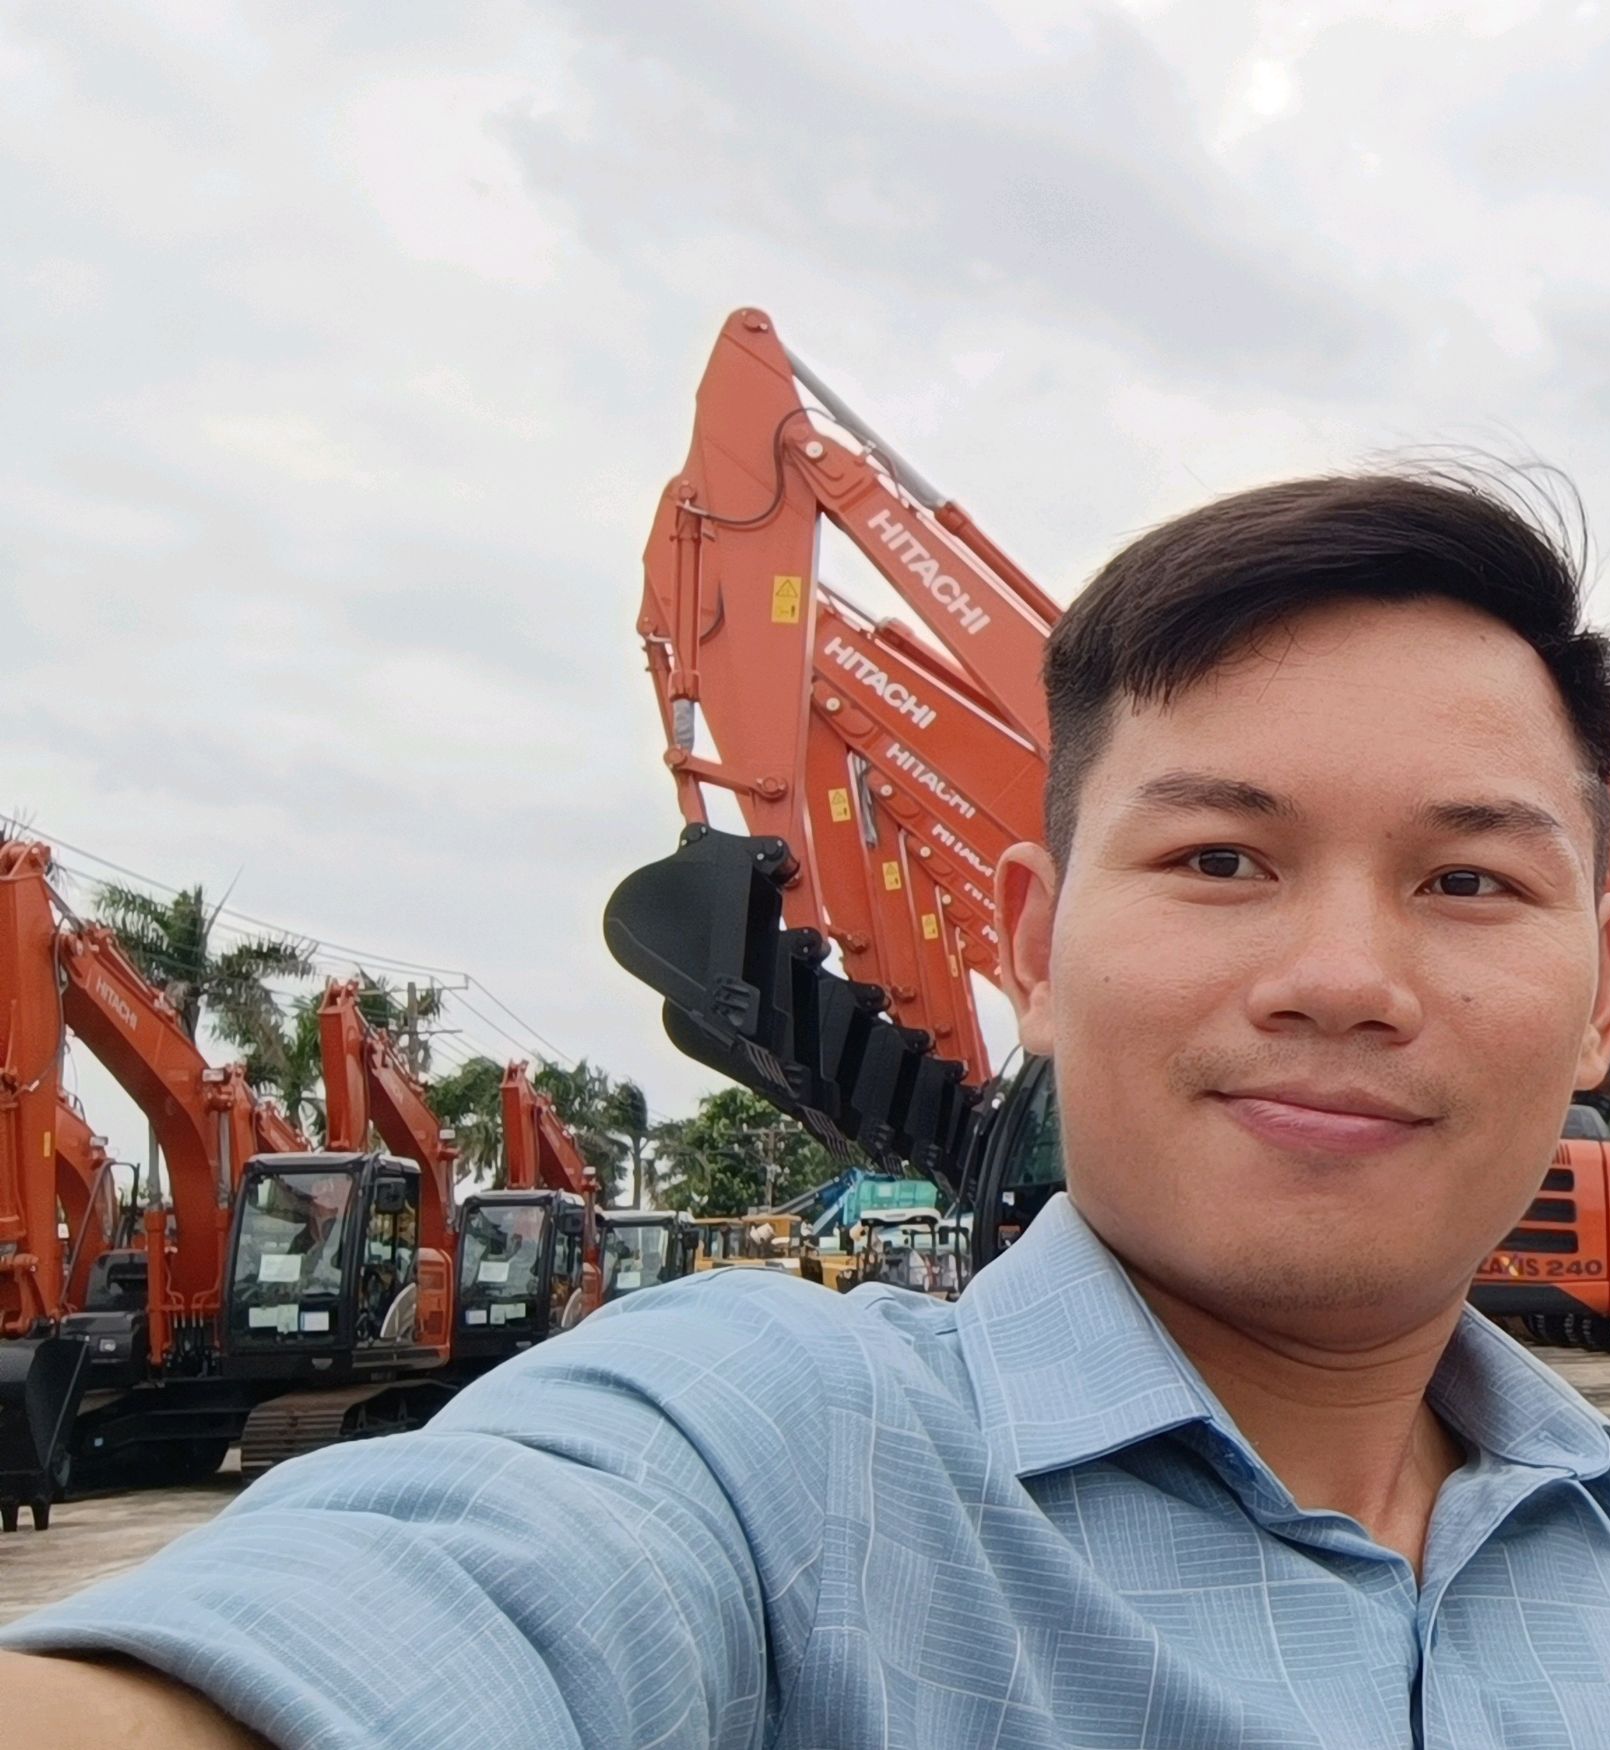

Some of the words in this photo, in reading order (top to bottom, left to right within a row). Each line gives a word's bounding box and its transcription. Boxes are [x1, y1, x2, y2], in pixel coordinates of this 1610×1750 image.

[867, 509, 991, 634] HITACHI
[824, 637, 937, 729] HITACHI
[1546, 1259, 1603, 1277] 240
